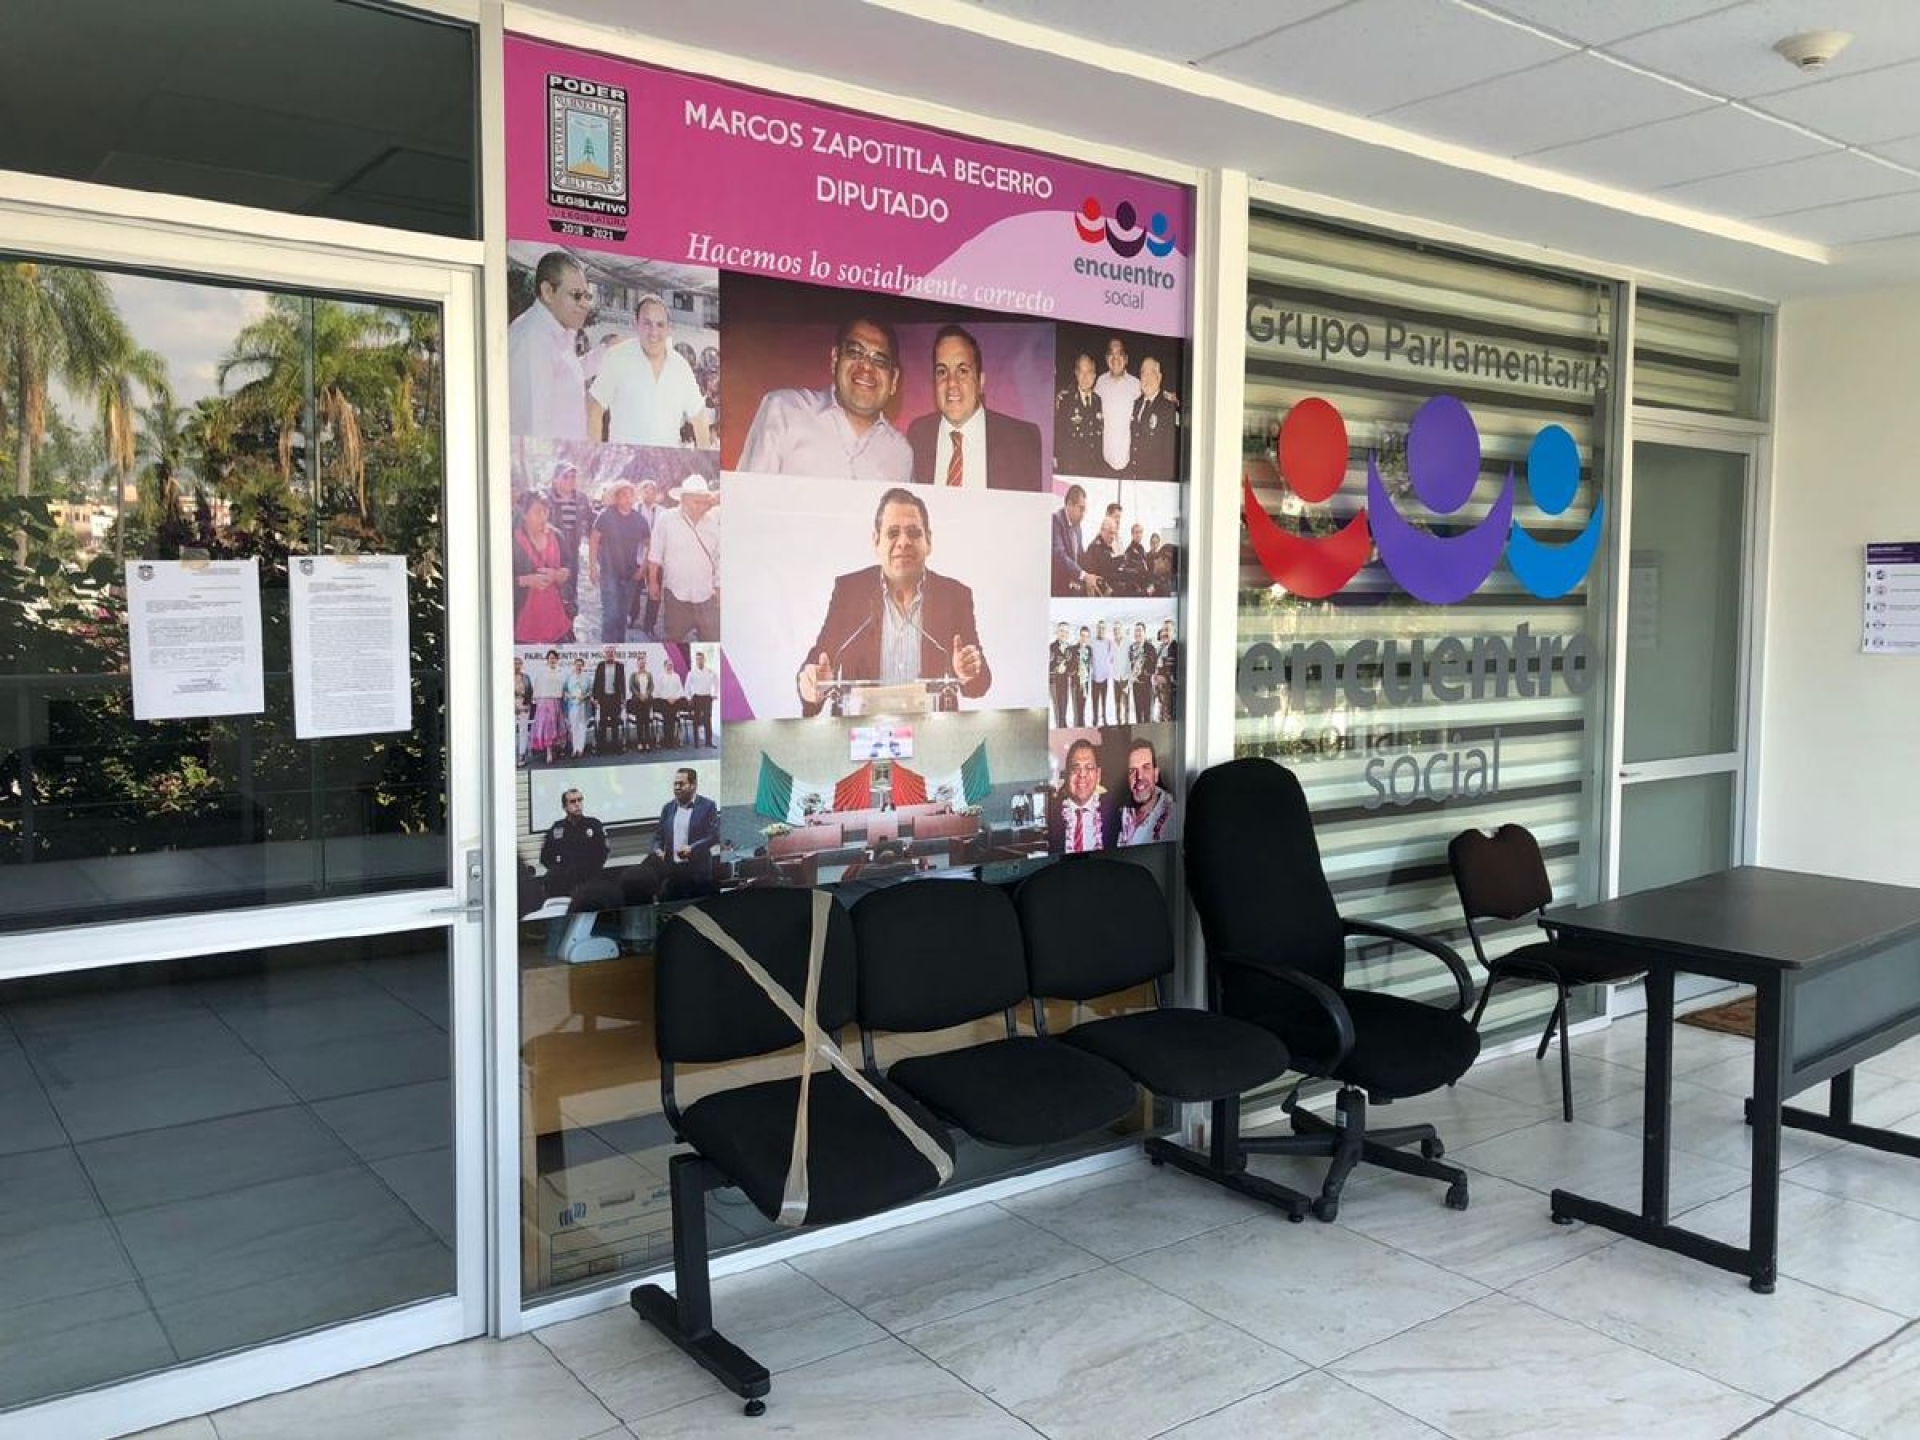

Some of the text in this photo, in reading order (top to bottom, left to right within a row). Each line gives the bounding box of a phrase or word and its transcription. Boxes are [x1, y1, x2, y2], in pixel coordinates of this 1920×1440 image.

[549, 75, 625, 100] PODER
[685, 100, 1054, 199] MARCOS ZAPOTITLA BECERRO
[551, 193, 627, 214] LEGISLATIVO
[816, 176, 949, 223] DIPUTADO
[687, 232, 1055, 313] Hacemos lo socialmente correcto
[1073, 256, 1175, 289] encuentro
[1105, 288, 1145, 310] social
[1246, 293, 1609, 390] Grupo Parlamentario
[1237, 622, 1600, 716] encuentro
[1364, 727, 1501, 809] social
